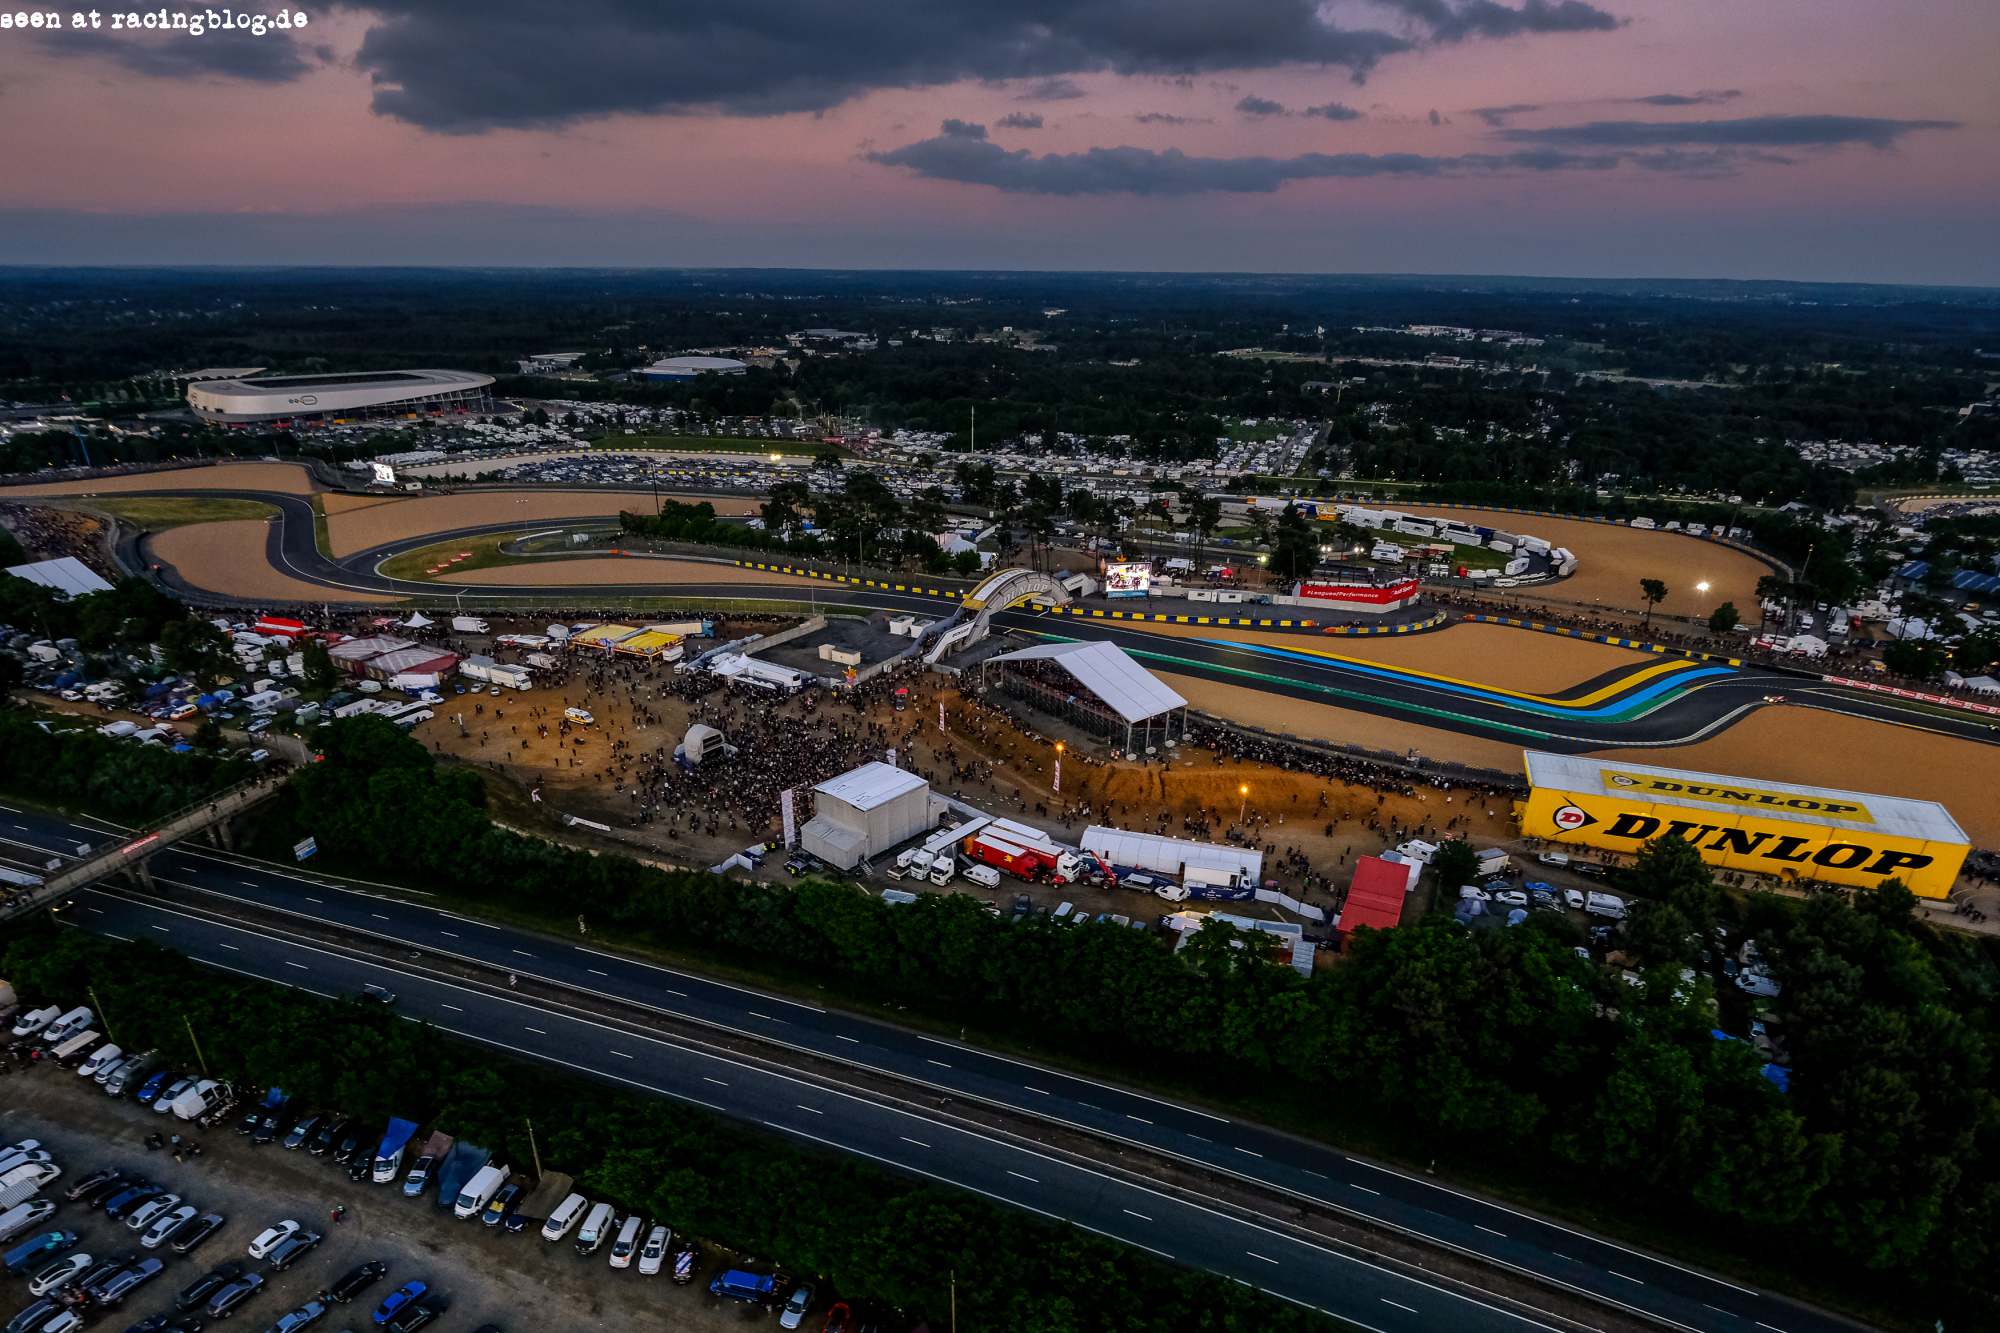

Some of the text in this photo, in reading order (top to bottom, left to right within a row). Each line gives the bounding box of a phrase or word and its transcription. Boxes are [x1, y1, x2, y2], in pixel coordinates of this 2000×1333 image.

[1004, 583, 1049, 604] DUNLOP
[1648, 780, 1859, 814] DUNLOP
[1603, 813, 1934, 875] DUNLOP
